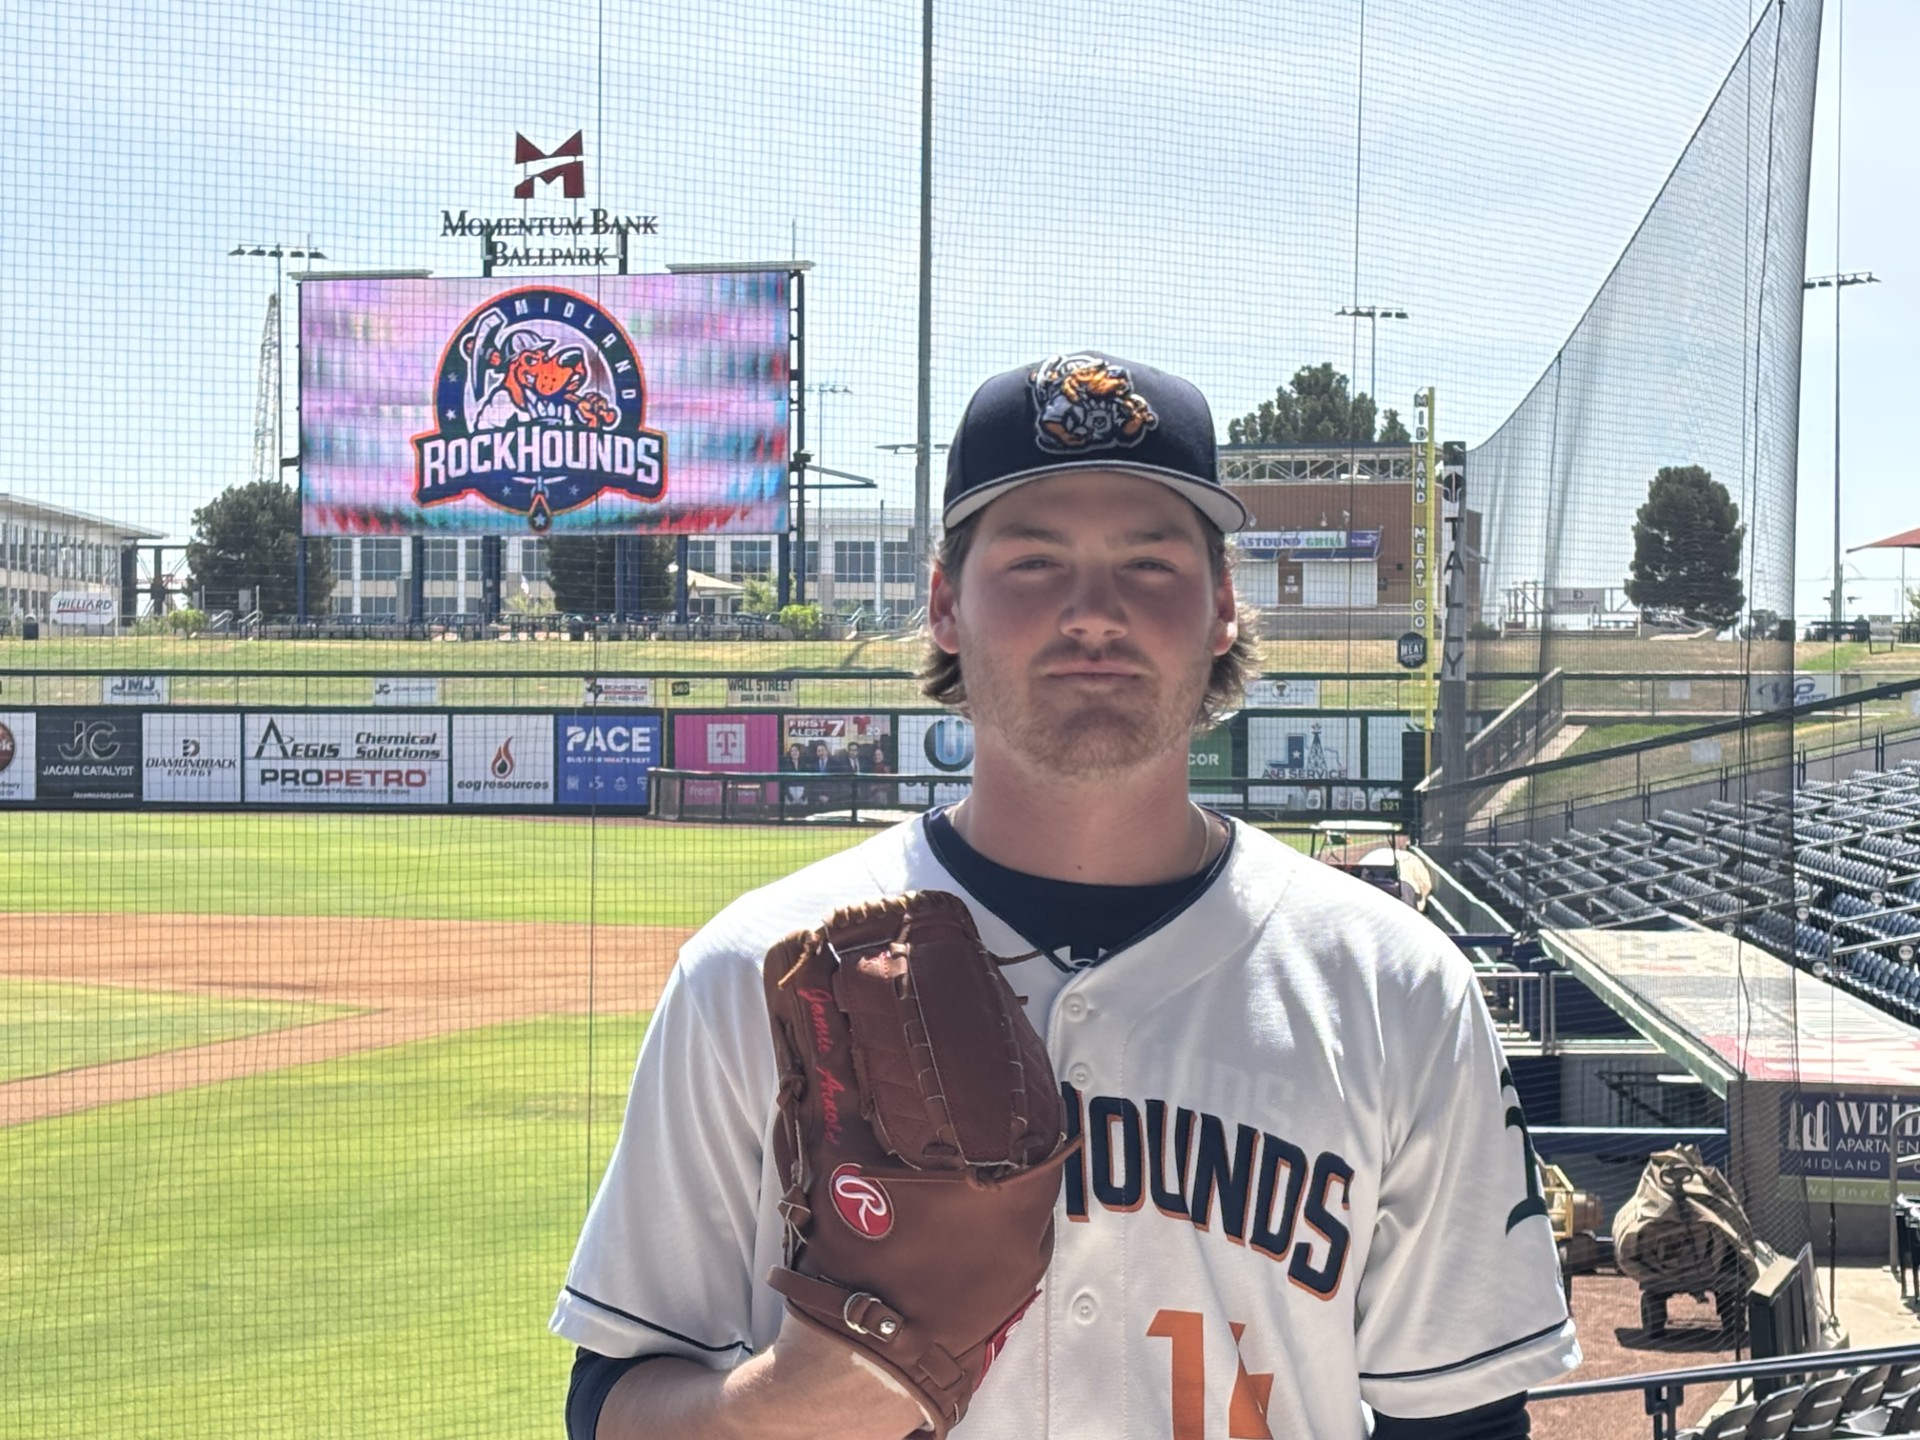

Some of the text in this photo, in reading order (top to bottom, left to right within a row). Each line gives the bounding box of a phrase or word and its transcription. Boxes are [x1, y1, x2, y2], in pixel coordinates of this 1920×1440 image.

[514, 297, 637, 400] MIDLAND
[423, 426, 659, 488] ROCKHOUNDS
[1414, 393, 1428, 628] MIDLAND MEAT CO
[57, 600, 112, 611] HILLIARD
[728, 677, 793, 692] WALL STREET
[789, 720, 845, 736] FIRST 7
[789, 728, 825, 736] ALERT
[867, 728, 881, 736] 20
[255, 717, 341, 759] AEGIS
[355, 732, 437, 745] Chemical
[567, 726, 650, 752] PACE
[356, 746, 441, 759] Solutions
[145, 757, 237, 769] DIAMONDBACK
[43, 765, 134, 776] JACAM CATALYST
[167, 768, 212, 777] ENERGY
[1289, 769, 1347, 779] SERVICE
[261, 769, 427, 787] PROPETRO
[457, 780, 549, 791] eog resources
[1382, 801, 1400, 812] 321
